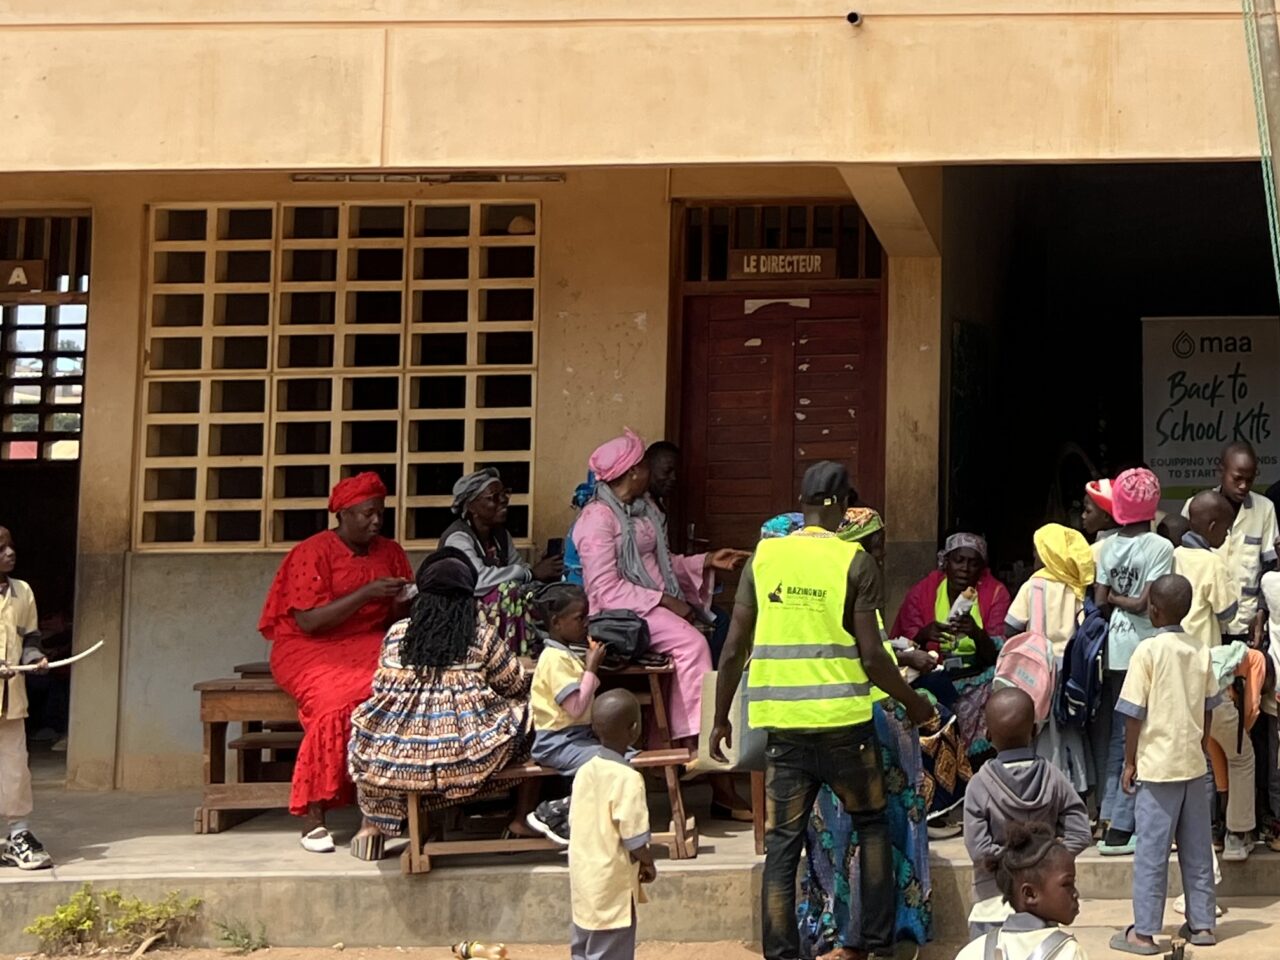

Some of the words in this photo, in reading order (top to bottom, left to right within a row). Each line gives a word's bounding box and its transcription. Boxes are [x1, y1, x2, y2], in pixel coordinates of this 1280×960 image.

[743, 255, 757, 273] LE
[760, 255, 822, 273] DIRECTEUR
[8, 266, 28, 285] A
[1200, 335, 1252, 353] maa
[1167, 370, 1225, 408] Back
[1227, 361, 1248, 405] to
[1156, 408, 1227, 447] School
[1150, 457, 1205, 467] EQUIPPING
[1168, 469, 1182, 478] TO
[1184, 469, 1217, 478] START
